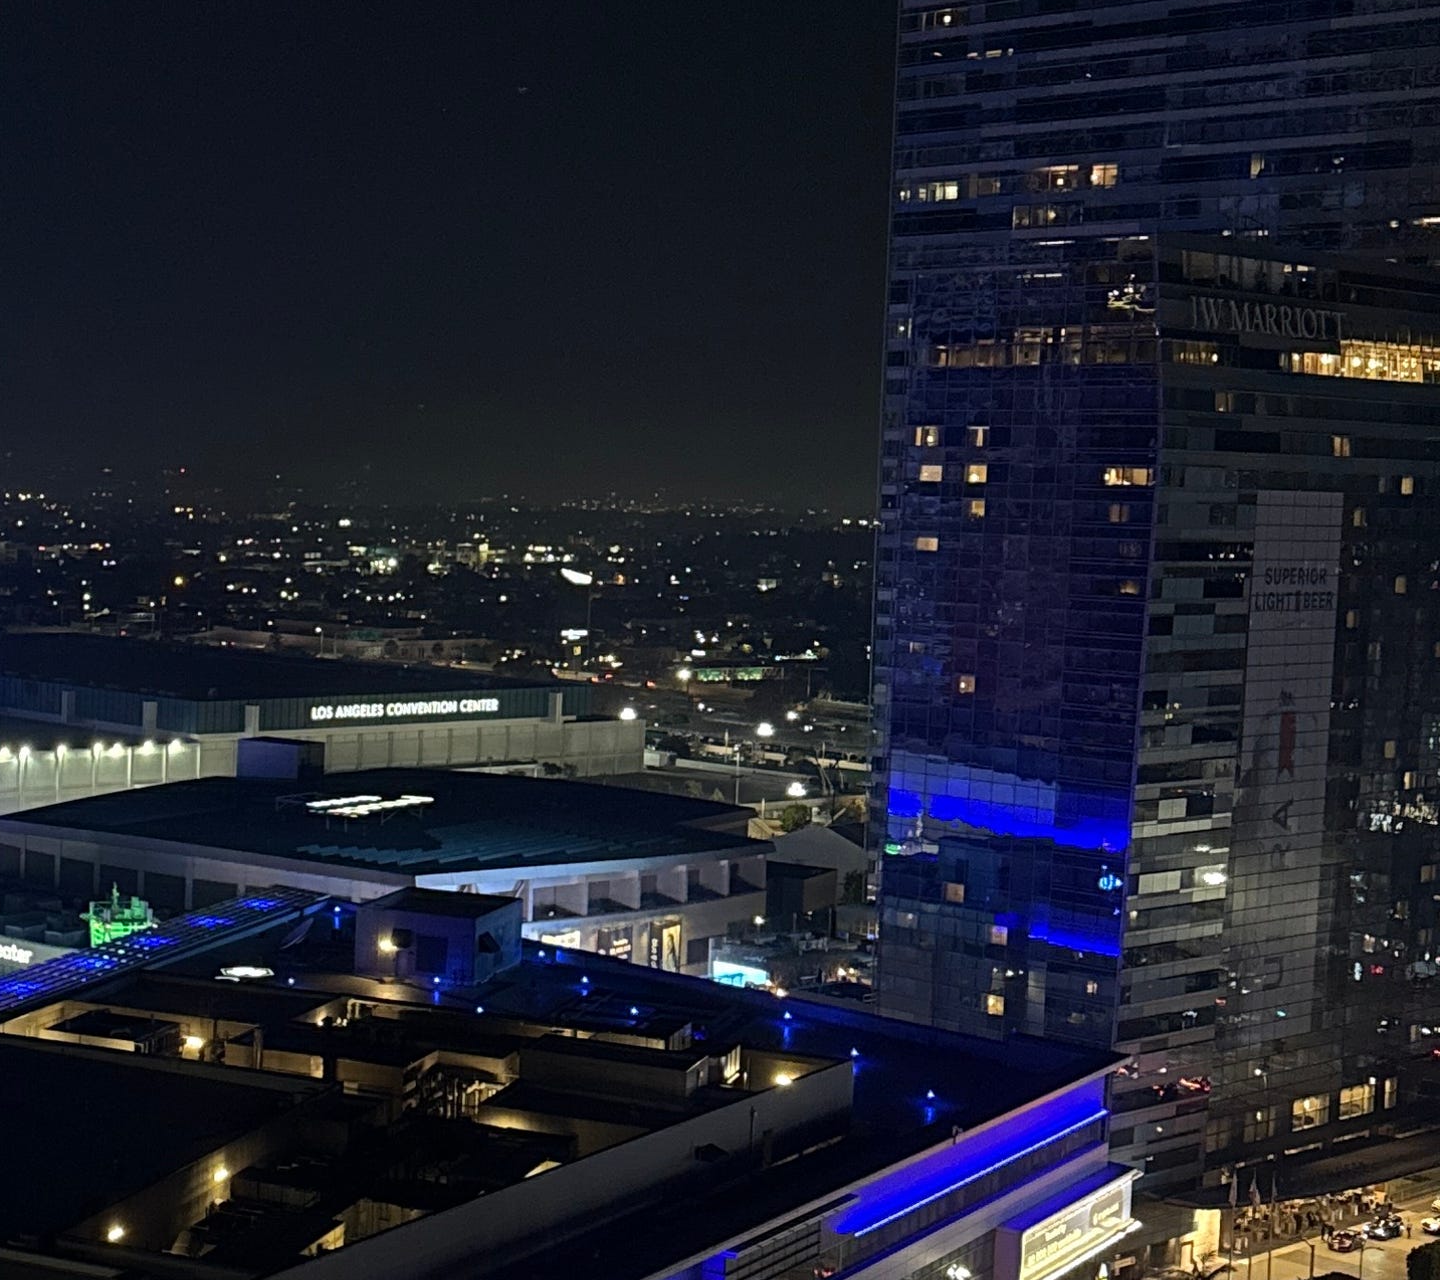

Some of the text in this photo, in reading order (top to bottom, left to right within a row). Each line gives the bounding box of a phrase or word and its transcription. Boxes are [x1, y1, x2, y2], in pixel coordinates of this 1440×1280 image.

[1191, 295, 1347, 341] JW MARRIOTT
[1264, 566, 1327, 587] SUPERIOR
[1254, 590, 1336, 614] LIGHT BEER
[311, 697, 499, 720] LOS ANGELES CONVENTION CENTER
